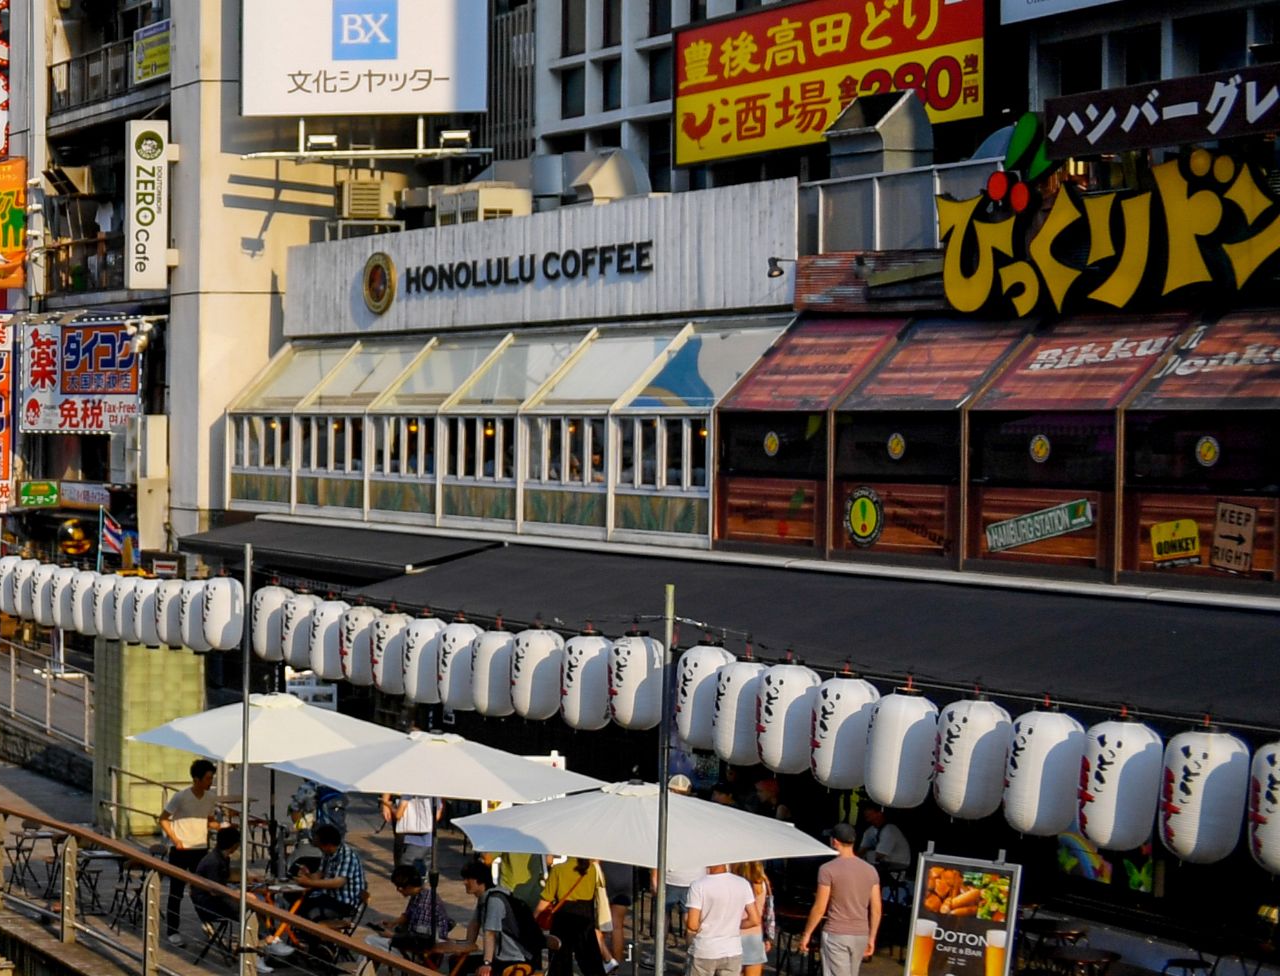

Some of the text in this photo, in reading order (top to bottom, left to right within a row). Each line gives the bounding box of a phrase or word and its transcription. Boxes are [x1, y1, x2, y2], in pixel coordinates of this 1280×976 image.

[341, 13, 390, 44] BX
[680, 0, 939, 89] 豊後高田どり
[718, 80, 832, 144] 酒場
[135, 165, 156, 227] ZERO
[935, 148, 1280, 318] びっくりドン
[405, 240, 654, 294] HONOLULU COFFEE
[30, 328, 58, 393] 薬
[62, 332, 138, 371] ダイコク
[58, 397, 104, 430] 免税
[103, 402, 137, 414] Tax-Free
[990, 507, 1070, 549] HAMBURG STATION
[1220, 508, 1252, 527] KEEP
[1156, 536, 1197, 555] DONKEY
[1212, 546, 1252, 571] RIGHT
[932, 926, 989, 947] DOTON
[964, 946, 983, 957] BAR
